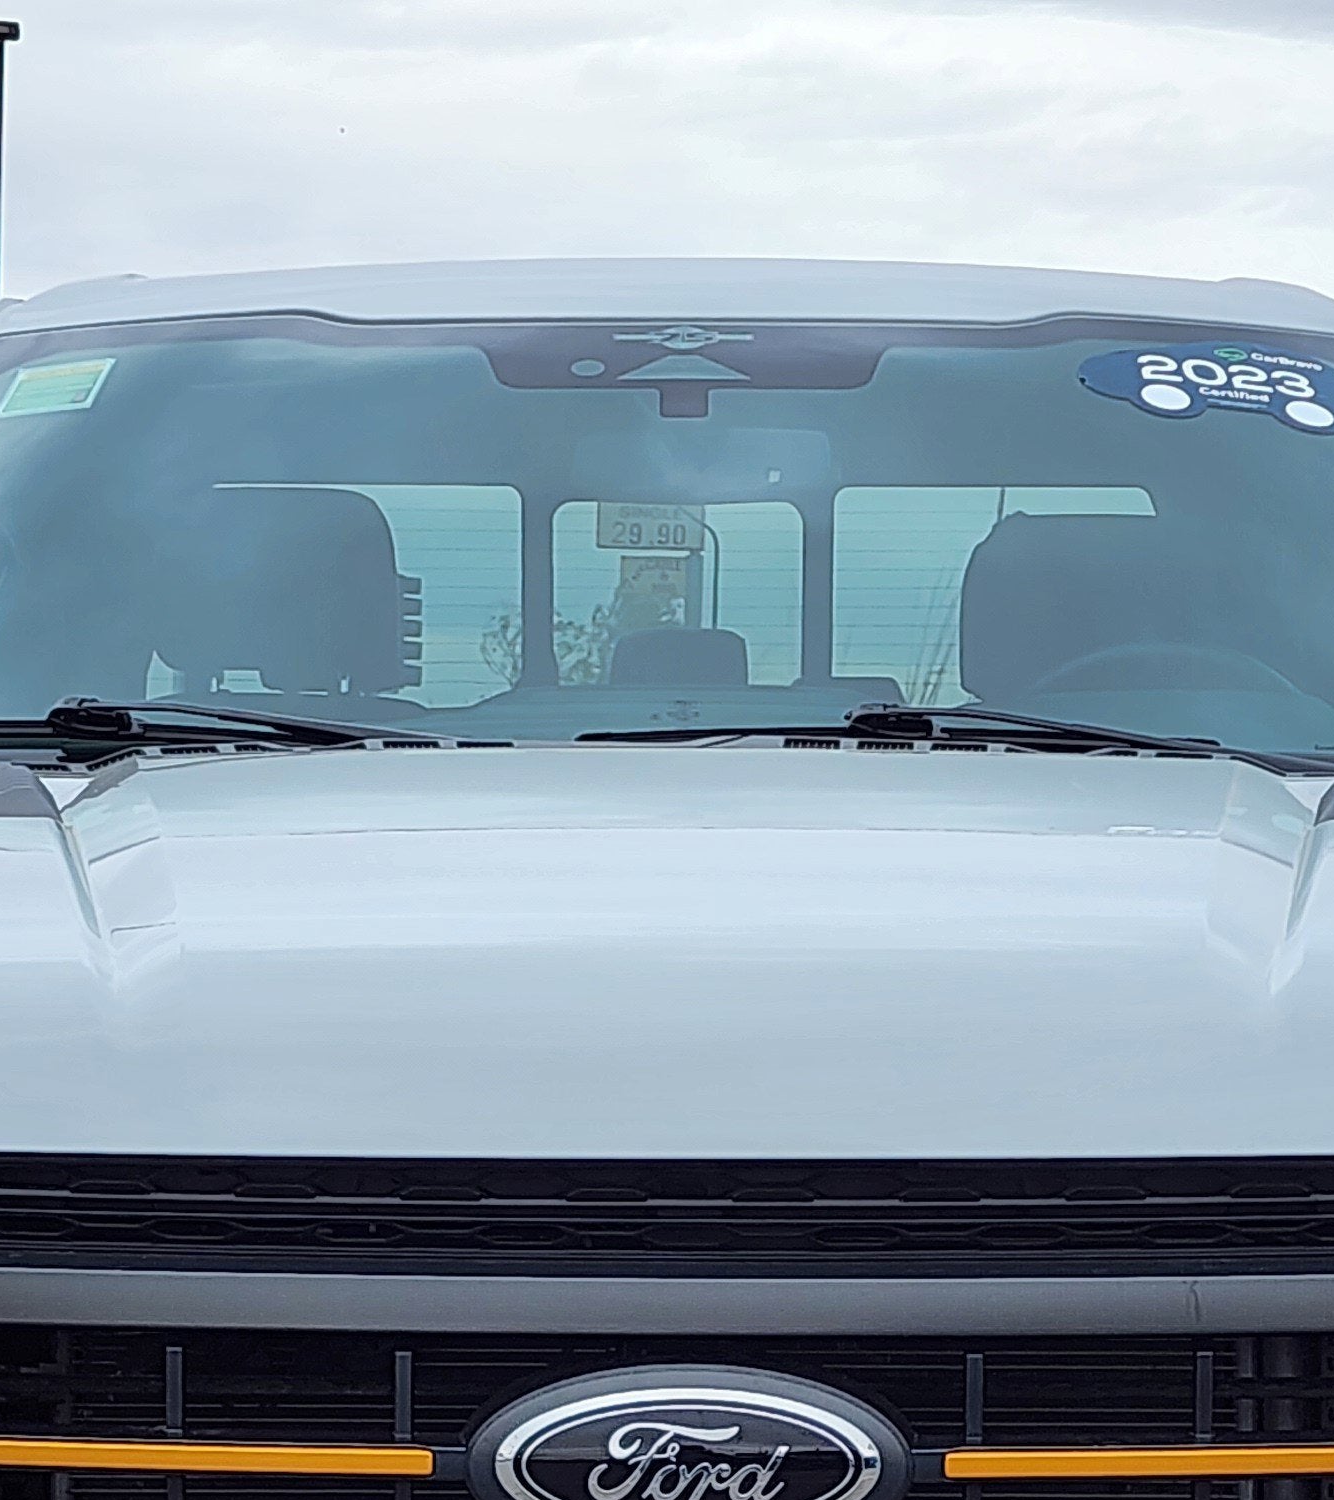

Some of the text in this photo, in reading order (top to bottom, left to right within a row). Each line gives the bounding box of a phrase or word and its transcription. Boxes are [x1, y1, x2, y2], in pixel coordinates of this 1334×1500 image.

[1136, 354, 1316, 398] 2023
[1198, 386, 1271, 402] Certified
[611, 521, 686, 545] 29.90
